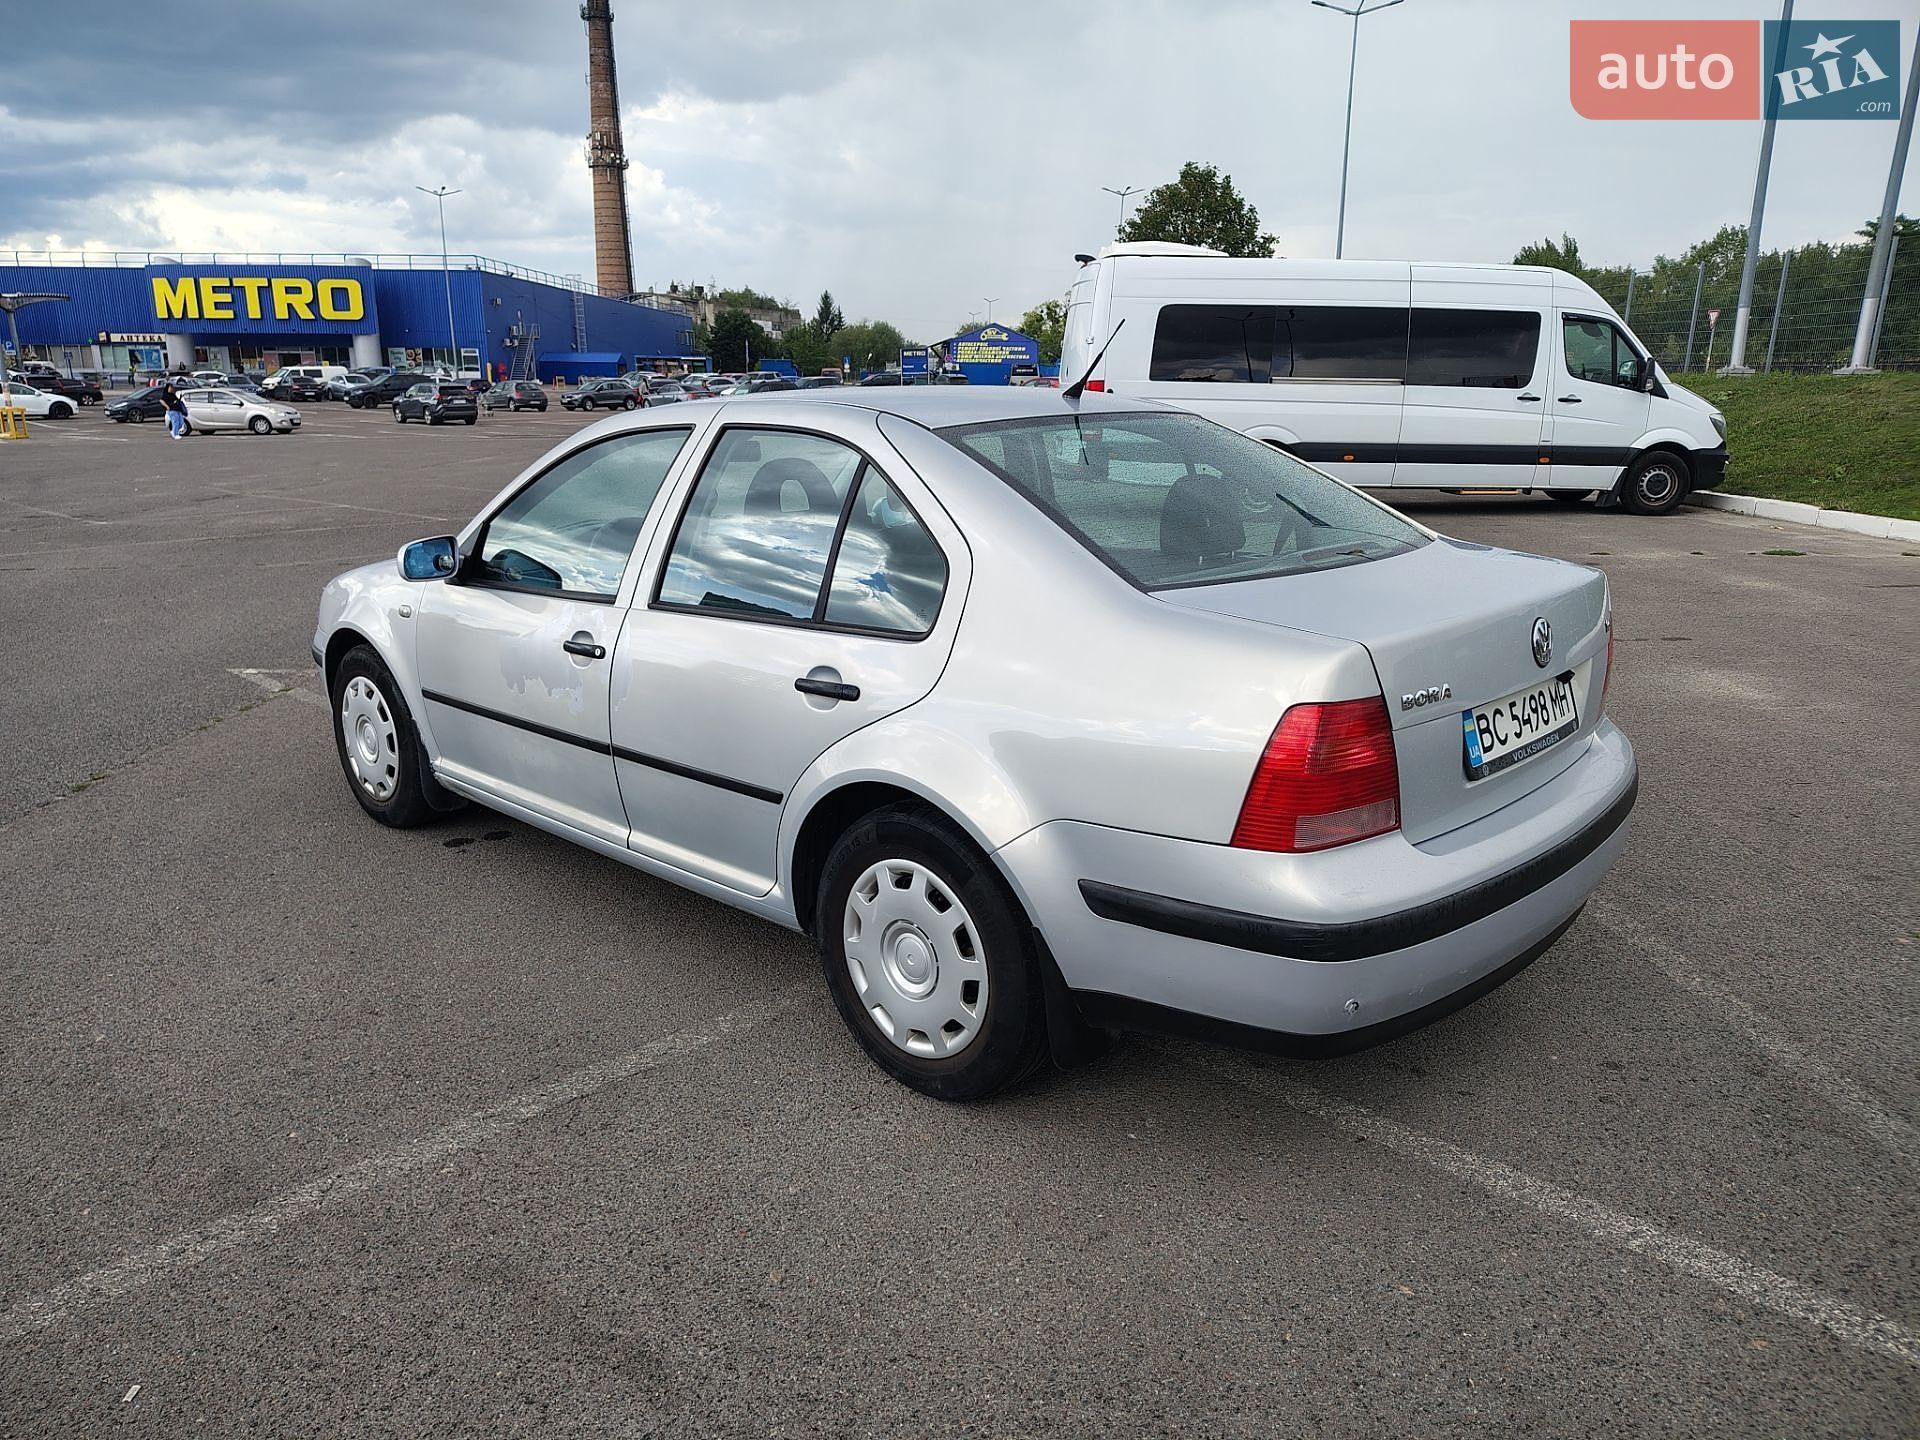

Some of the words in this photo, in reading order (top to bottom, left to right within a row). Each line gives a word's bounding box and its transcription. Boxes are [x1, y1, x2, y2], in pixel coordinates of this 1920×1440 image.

[152, 277, 365, 321] METRO
[1401, 683, 1452, 711] BORA
[1475, 707, 1509, 754] BC
[1509, 690, 1550, 739] 5498
[1469, 745, 1481, 759] UA
[1512, 732, 1560, 761] VOLKSWAGEN
